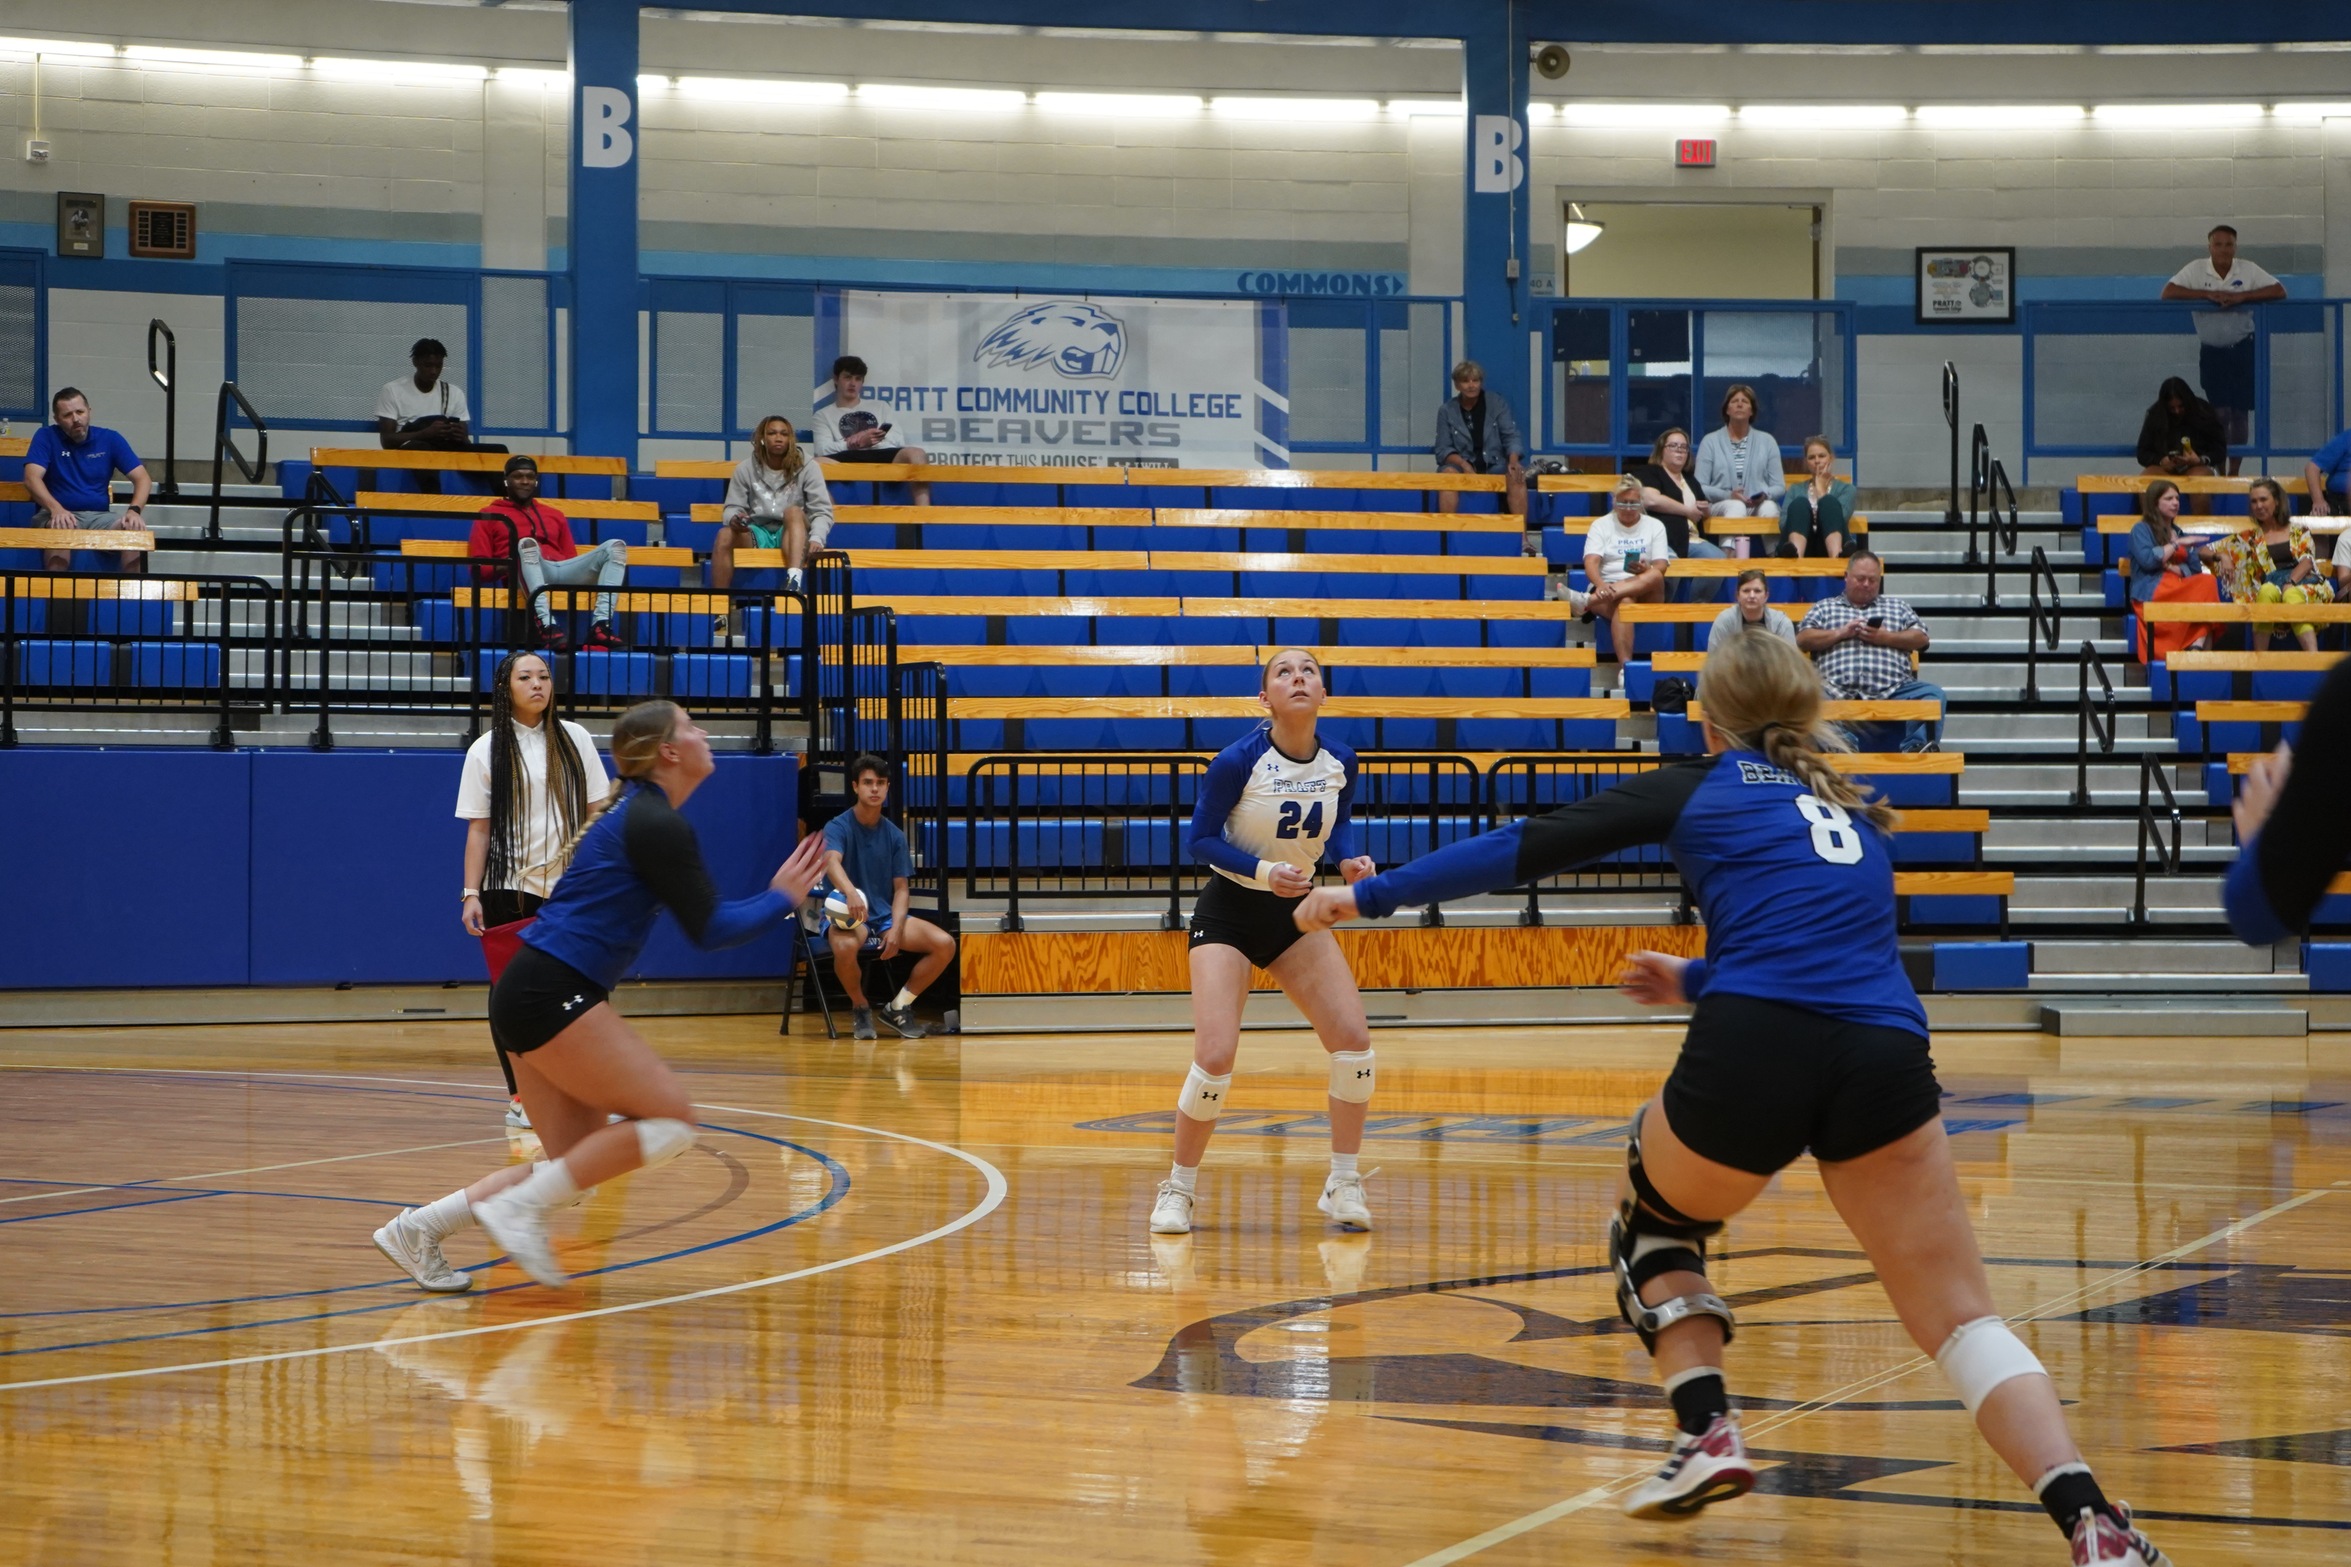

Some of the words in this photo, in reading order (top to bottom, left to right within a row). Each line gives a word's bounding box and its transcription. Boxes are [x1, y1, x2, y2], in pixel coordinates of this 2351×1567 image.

[583, 86, 633, 168] B
[1475, 115, 1524, 193] B
[1681, 139, 1713, 163] EXIT
[1237, 272, 1389, 295] COMMONS
[957, 387, 1110, 415] COMMUNITY
[1118, 390, 1242, 418] COLLEGE
[922, 418, 1181, 447] BEAVERS
[1273, 778, 1327, 793] PRATT
[1276, 801, 1323, 839] 24
[1795, 794, 1863, 865] 8
